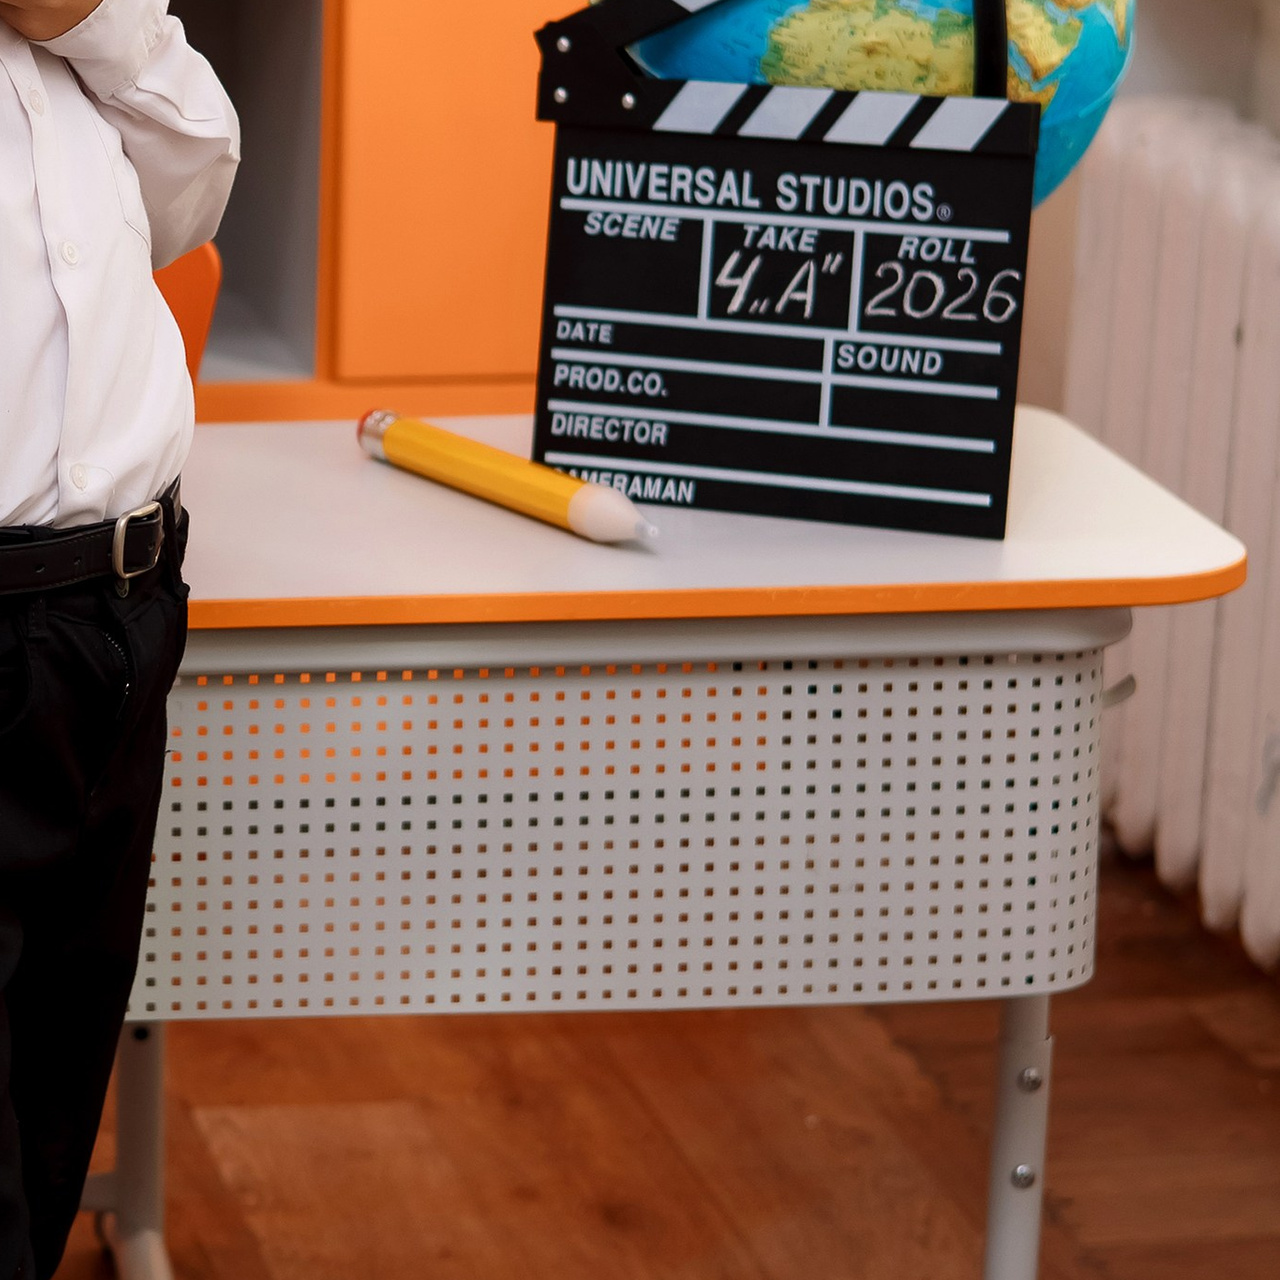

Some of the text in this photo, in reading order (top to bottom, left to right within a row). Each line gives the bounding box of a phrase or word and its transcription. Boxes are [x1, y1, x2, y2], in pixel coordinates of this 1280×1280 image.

[566, 157, 761, 208] UNIVERSAL
[584, 212, 680, 241] SCENE
[743, 225, 819, 252] TAKE
[898, 236, 977, 264] ROLL
[864, 261, 1021, 323] 2026
[556, 320, 613, 344] DATE
[836, 344, 944, 375] SOUND
[553, 363, 669, 397] PROD.CO.
[550, 412, 669, 446] DIRECTOR
